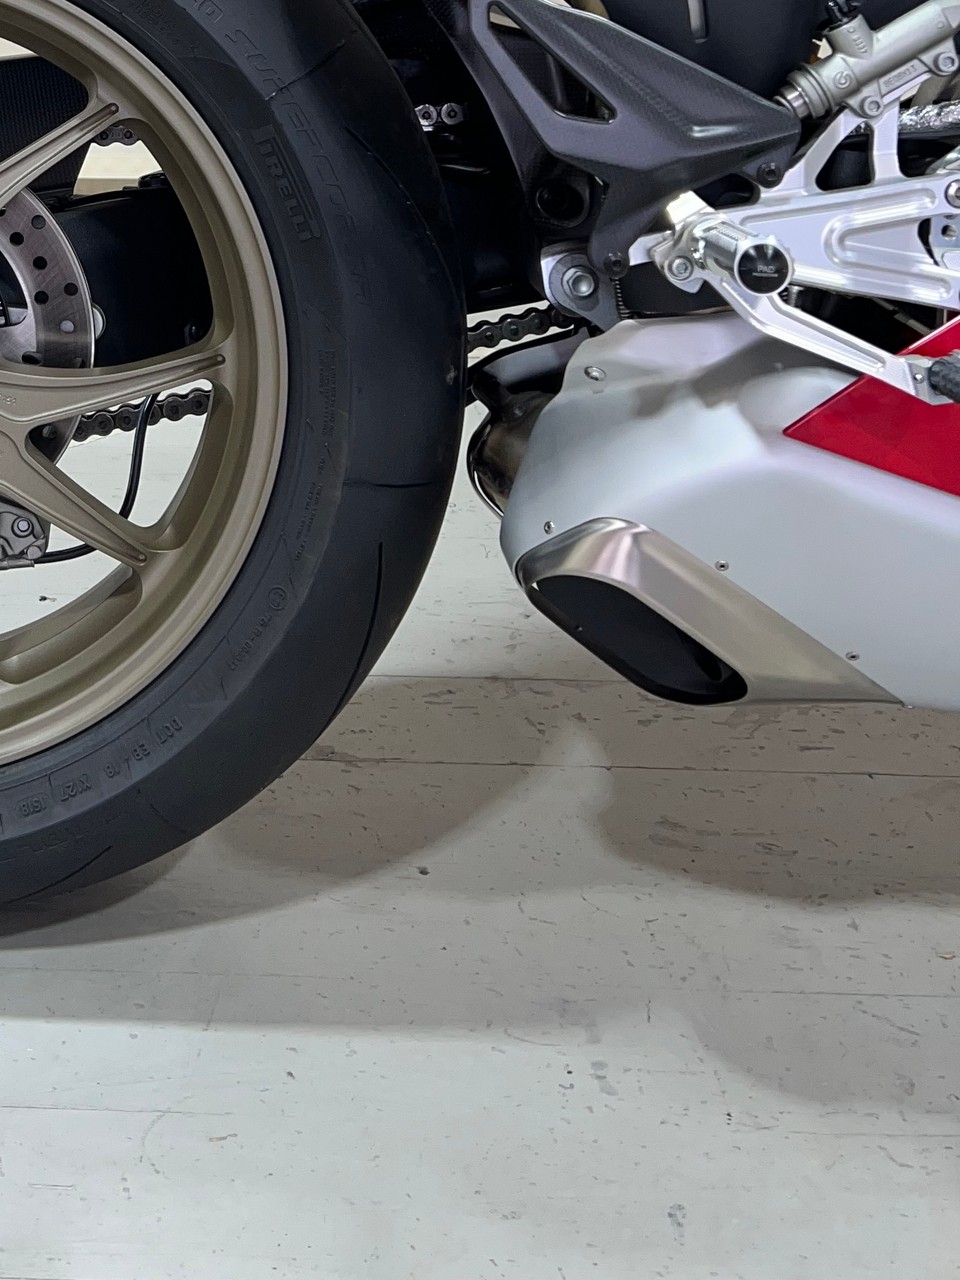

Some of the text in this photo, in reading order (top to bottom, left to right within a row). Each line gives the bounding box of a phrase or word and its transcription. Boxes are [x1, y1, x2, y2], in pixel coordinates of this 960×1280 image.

[249, 120, 321, 243] PIRELLI
[152, 715, 185, 745] DOT
[18, 794, 47, 818] 1518
